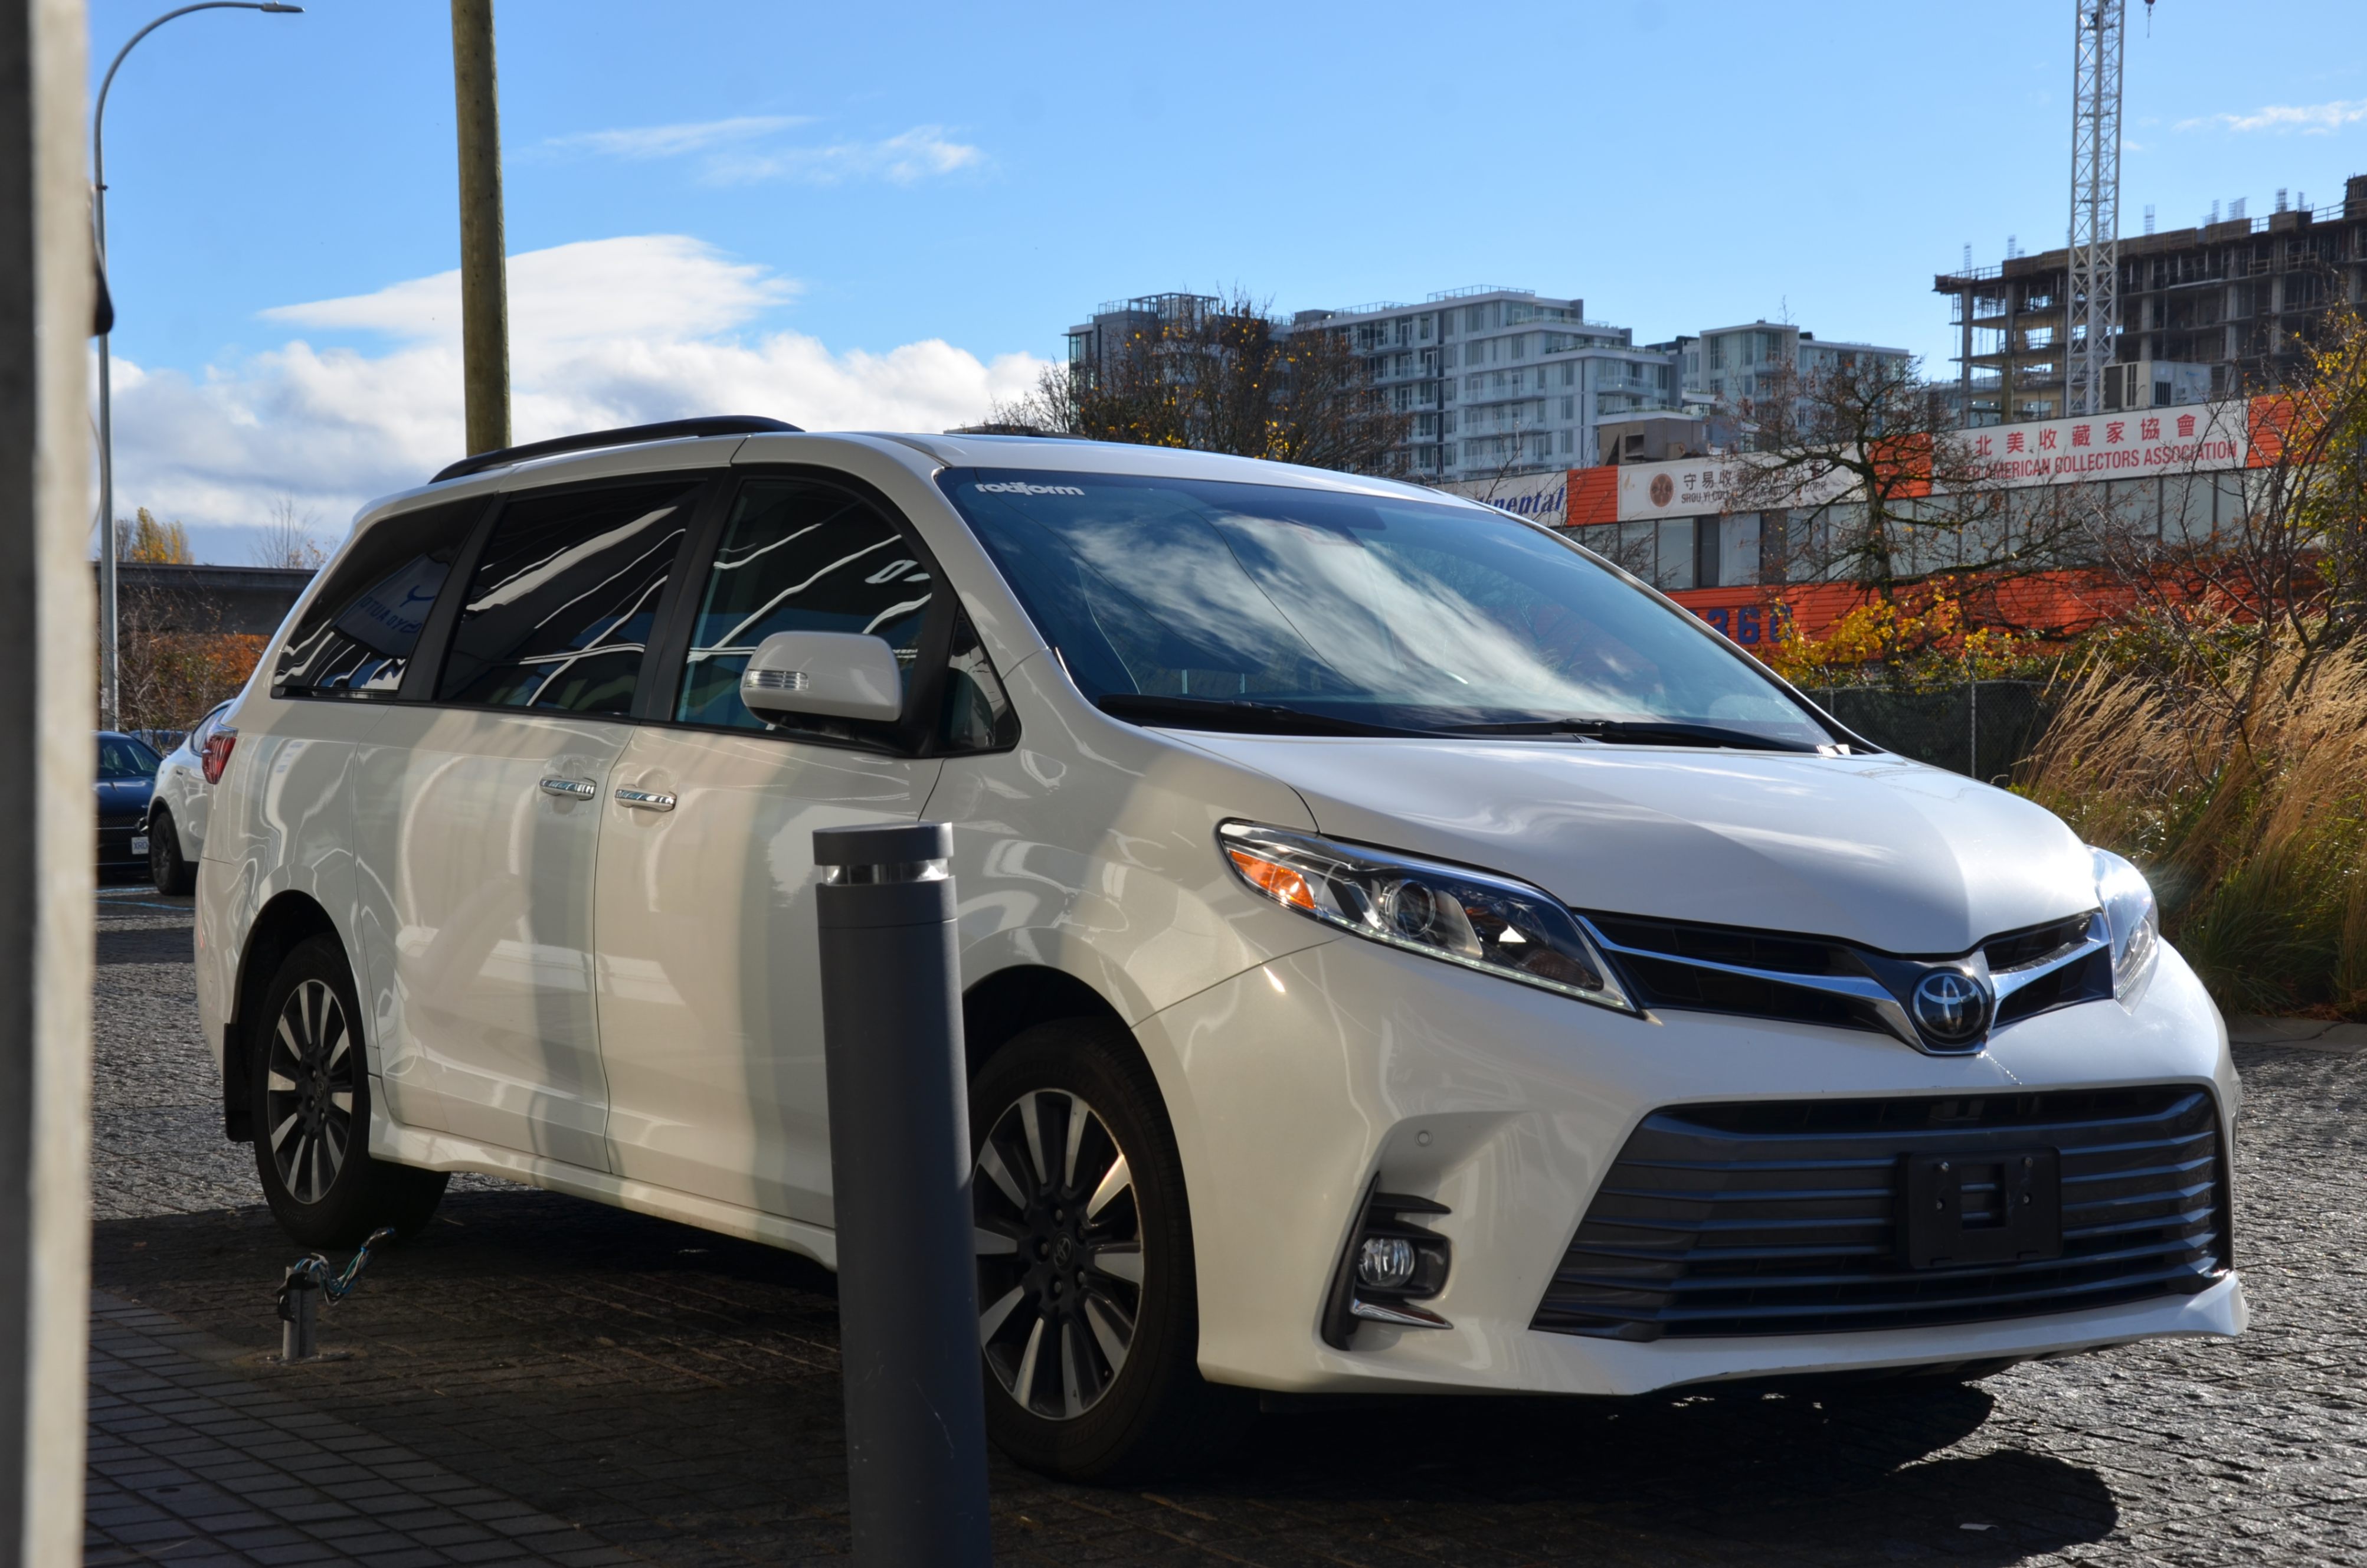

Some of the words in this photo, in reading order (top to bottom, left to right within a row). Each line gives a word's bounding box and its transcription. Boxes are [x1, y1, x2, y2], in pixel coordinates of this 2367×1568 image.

[1975, 413, 2196, 457] 北美收藏家協會
[2055, 449, 2139, 473] COLLECTORS
[2143, 440, 2238, 466] ASSOCIATION
[974, 482, 1085, 495] rotiform
[1690, 604, 1793, 644] 360
